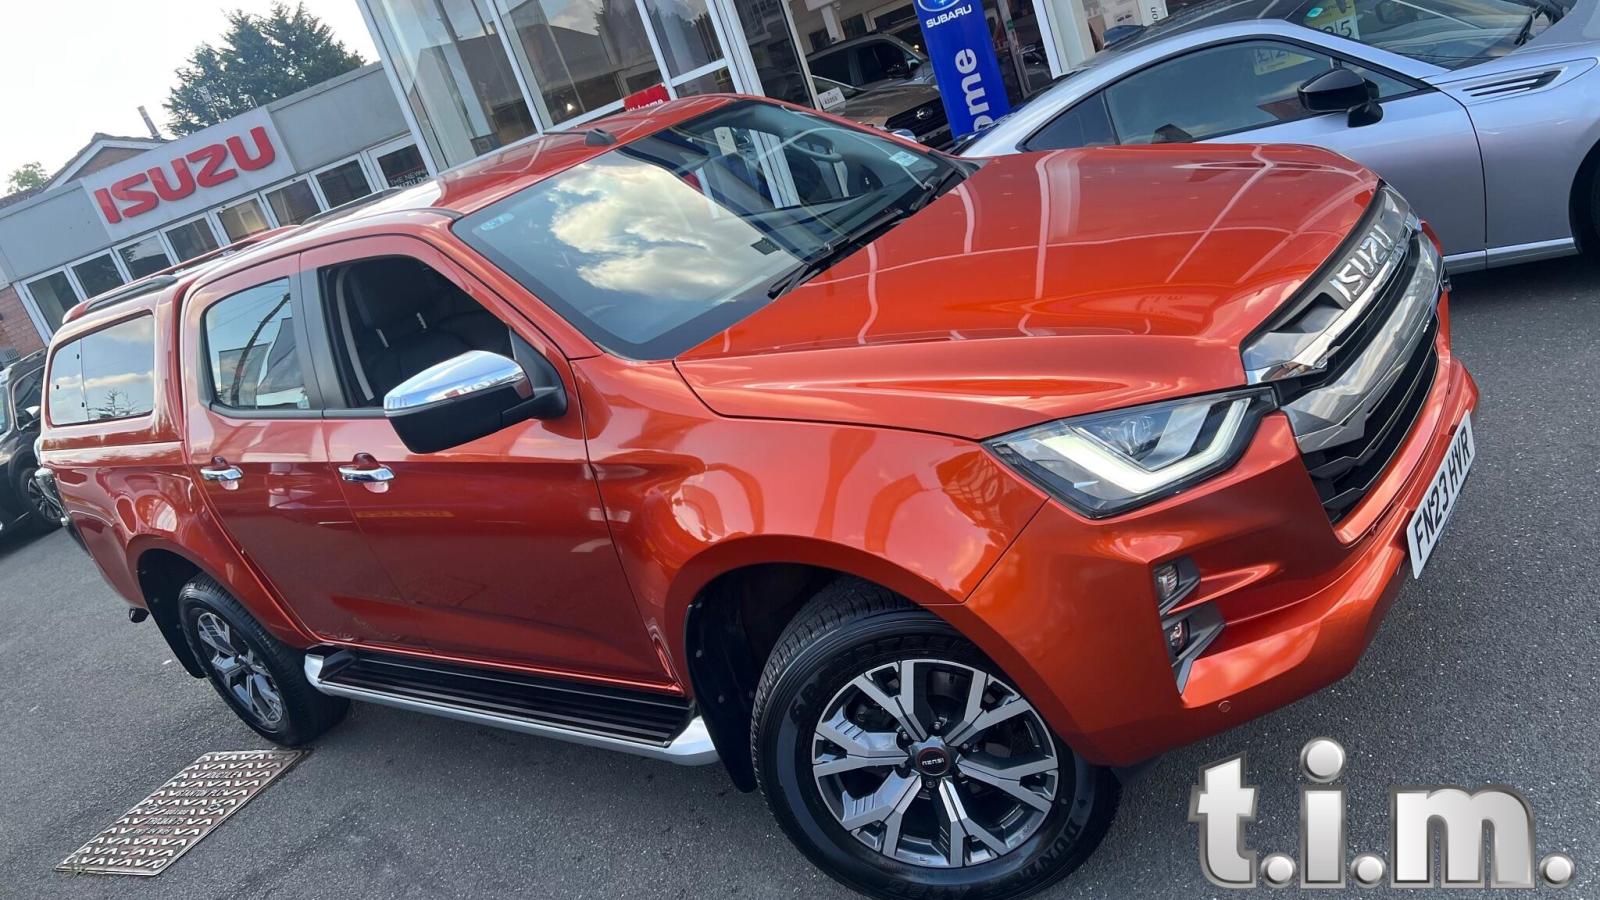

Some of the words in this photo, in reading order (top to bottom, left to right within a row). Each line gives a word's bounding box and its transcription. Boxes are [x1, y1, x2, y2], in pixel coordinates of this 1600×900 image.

[926, 4, 972, 29] SUBARU
[94, 126, 276, 224] ISUZU
[1329, 224, 1394, 302] ISUZU
[1414, 470, 1449, 561] FN23
[1448, 426, 1471, 493] HVR
[921, 757, 944, 766] ISUZU
